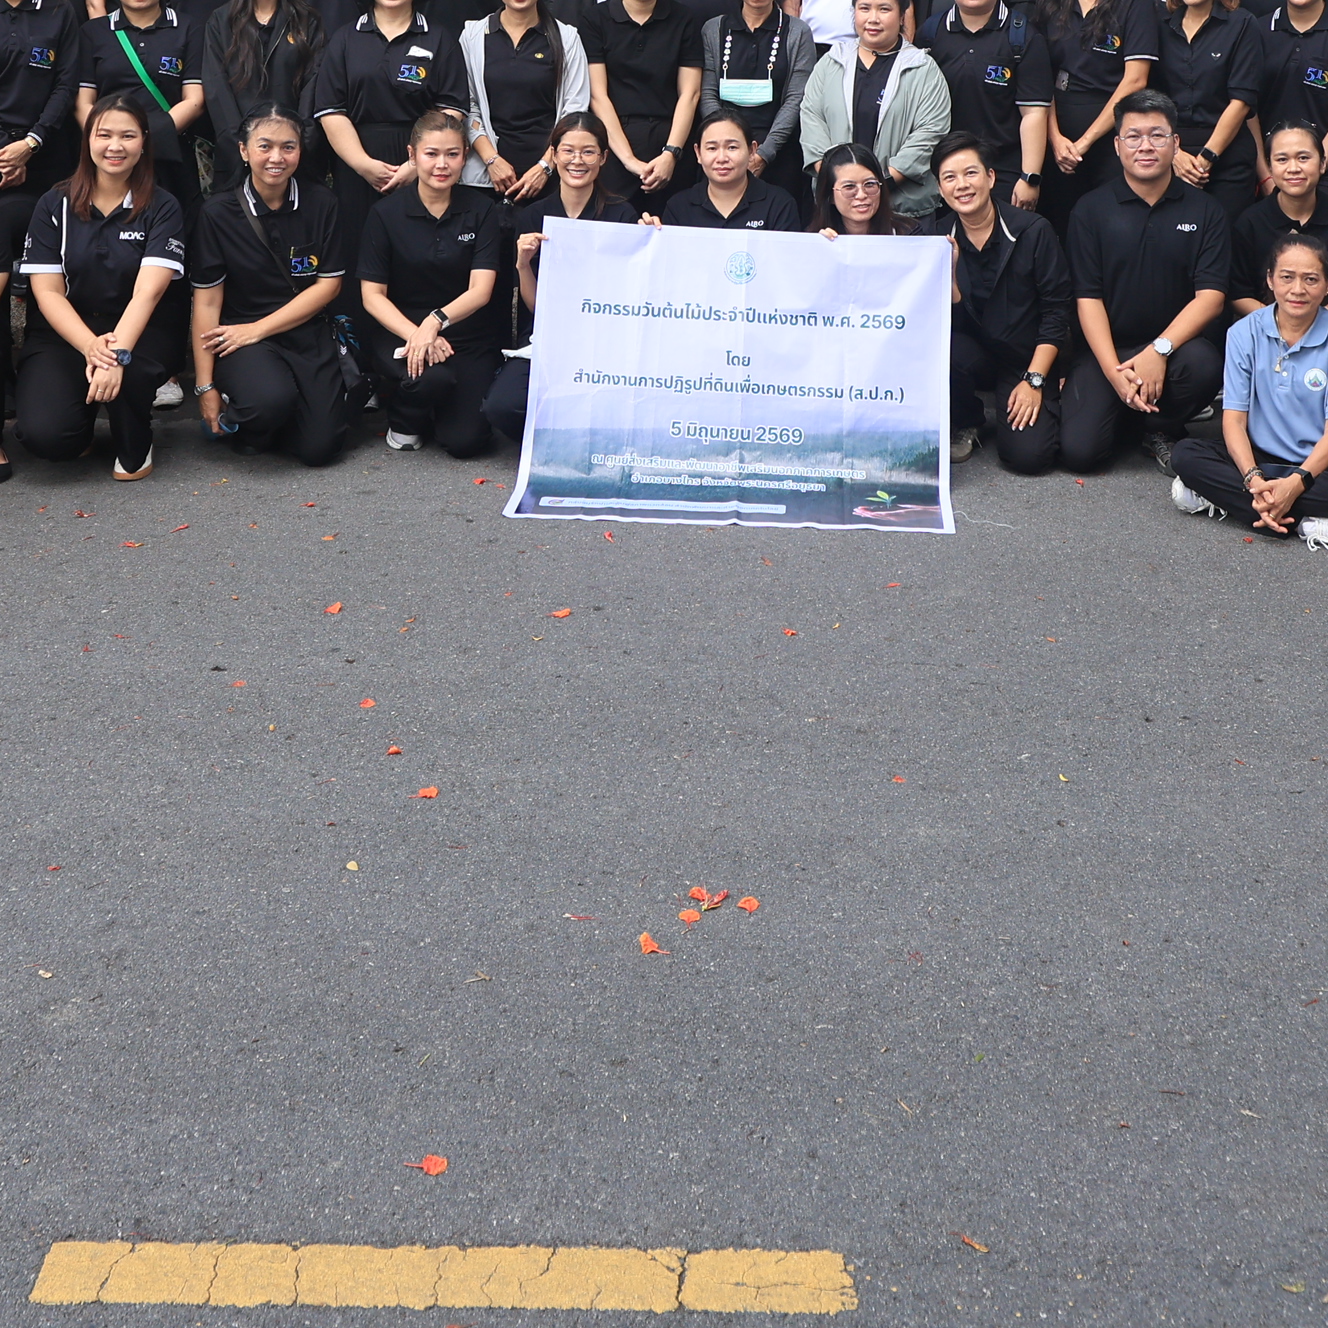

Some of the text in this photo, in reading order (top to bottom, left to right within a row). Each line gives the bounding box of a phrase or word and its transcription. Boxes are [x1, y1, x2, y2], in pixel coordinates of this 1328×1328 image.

[118, 231, 145, 241] MOAC
[581, 298, 906, 330] กิจกรรมวันต้นไม้ประจำปีแห่งชาติ พ.ศ. 2569
[725, 350, 751, 367] โดย
[573, 368, 905, 404] สำนักงานการปฏิรูปที่ดินเพื่อเกษตรกรรม (ส.ป.ก.)
[670, 420, 804, 444] 5 มิถุนายน 2569
[591, 454, 604, 465] ณ
